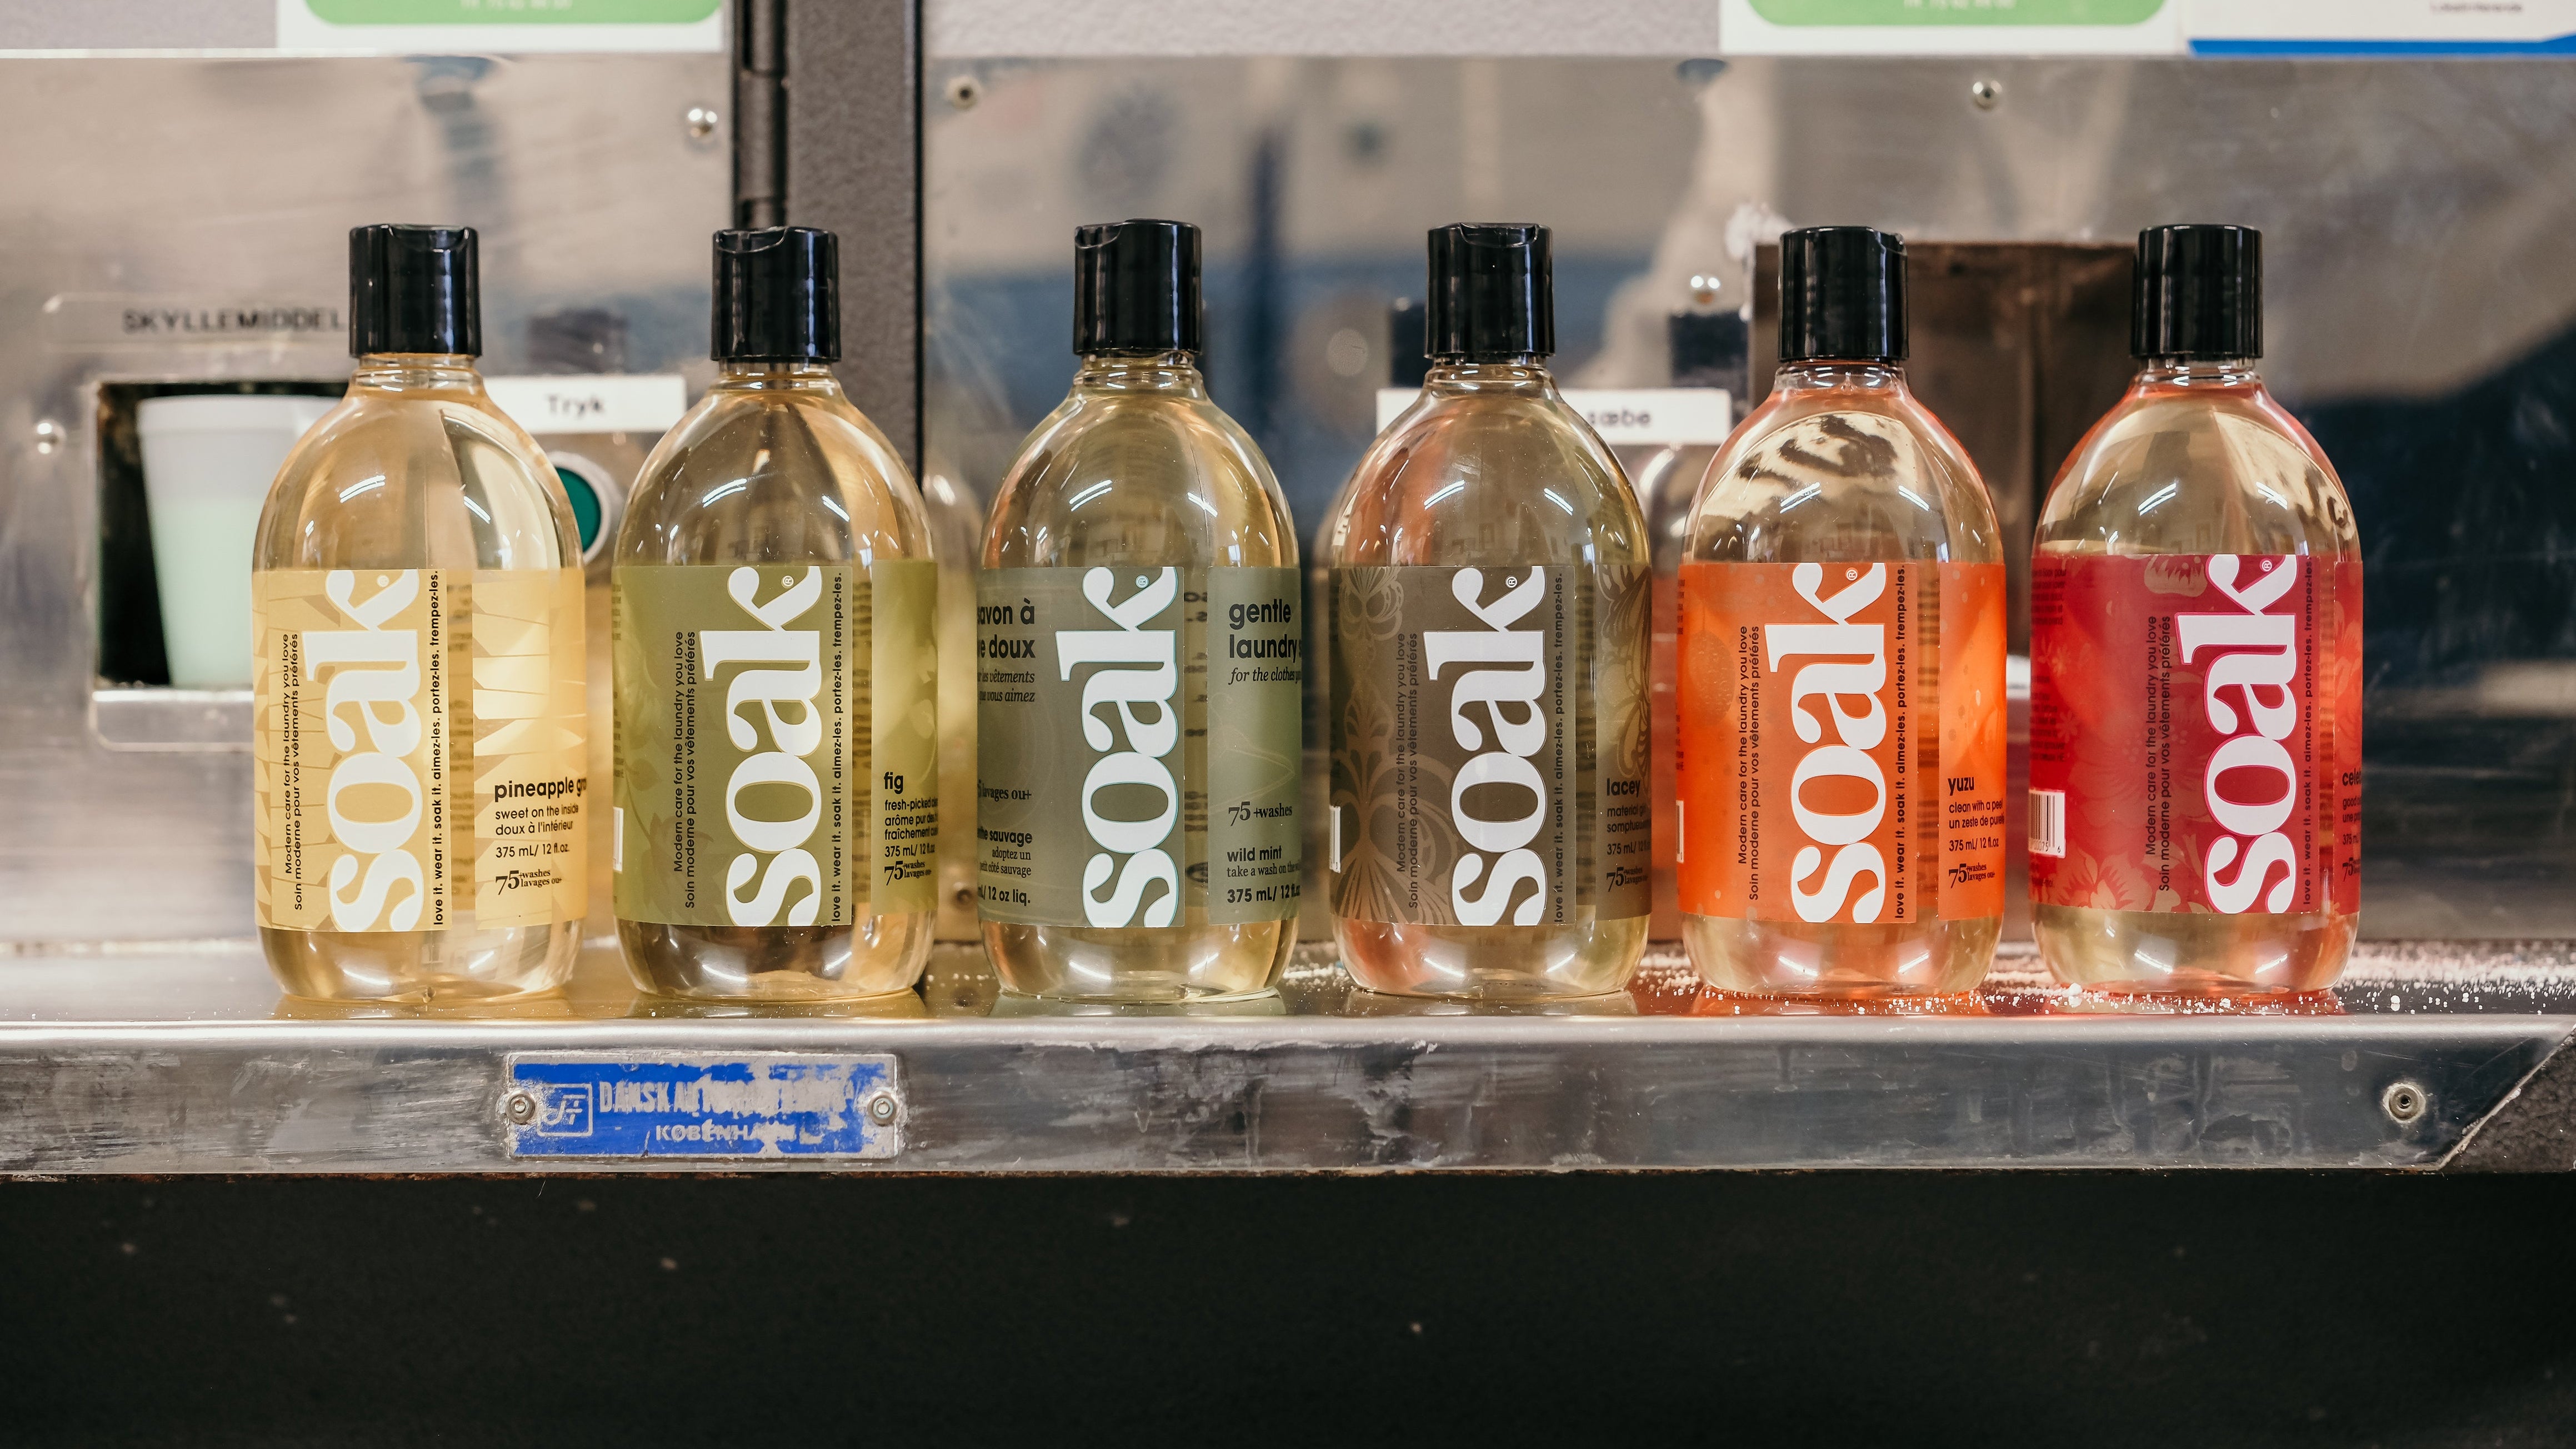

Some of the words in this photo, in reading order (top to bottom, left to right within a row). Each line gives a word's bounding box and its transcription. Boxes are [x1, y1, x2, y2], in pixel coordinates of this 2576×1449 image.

[1021, 598, 1035, 625] à
[1229, 599, 1291, 630] gentle
[1738, 626, 1748, 653] love
[2145, 615, 2157, 644] love
[281, 634, 289, 663] love
[685, 631, 697, 685] préférés
[989, 634, 1036, 658] doux
[1229, 634, 1297, 663] laundry
[2148, 646, 2160, 670] you
[289, 634, 300, 686] préférés
[1740, 656, 1750, 680] you
[283, 665, 292, 688] you
[990, 669, 1035, 683] vêtements
[1228, 667, 1249, 685] for
[1253, 666, 1268, 681] the
[1271, 666, 1295, 681] clothes
[987, 691, 1003, 701] vous
[1005, 688, 1036, 702] aimez
[2145, 674, 2159, 724] laundry
[282, 692, 293, 742] laundry
[1738, 684, 1750, 733] laundry
[290, 690, 299, 758] vêtements
[685, 688, 696, 756] vêtements
[2175, 554, 2298, 914] soak
[302, 569, 424, 931] soak
[699, 566, 822, 926] soak
[1056, 566, 1179, 927] soak
[1423, 566, 1547, 926] soak
[1738, 736, 1748, 757] the
[1764, 562, 1887, 923] soak
[2145, 727, 2157, 748] the
[283, 744, 291, 766] the
[2145, 751, 2157, 768] for
[686, 759, 695, 781] vos
[1738, 760, 1748, 778] for
[494, 776, 574, 802] pineapple
[884, 771, 903, 794] fig
[1606, 778, 1640, 797] lacey
[1948, 777, 1974, 796] yuzu
[2147, 771, 2157, 801] care
[293, 786, 302, 816] pour
[686, 784, 697, 815] pour
[884, 798, 931, 812] fresh-picked
[1739, 781, 1748, 811] care
[1895, 793, 1905, 823] soak
[1949, 801, 1970, 813] clean
[1972, 800, 1984, 811] with
[1986, 801, 1990, 810] a
[431, 799, 442, 829] soak
[495, 808, 528, 820] sweet
[531, 808, 544, 818] on
[547, 805, 559, 816] the
[561, 803, 579, 815] inside
[831, 798, 842, 828] soak
[884, 814, 914, 826] arôme
[916, 815, 926, 827] pur
[1228, 801, 1251, 826] 75
[1949, 820, 1960, 829] un
[1962, 816, 1978, 828] zeste
[1980, 815, 1988, 826] de
[496, 824, 525, 835] doux
[528, 821, 535, 833] à
[538, 820, 573, 833] l'intérieur
[884, 827, 930, 840] fraîchement
[989, 830, 1032, 847] sauvage
[1738, 814, 1748, 864] Modern
[2145, 805, 2157, 855] Modern
[293, 820, 302, 879] moderne
[496, 846, 515, 858] 375
[542, 843, 552, 854] 12
[685, 818, 695, 878] moderne
[884, 846, 901, 858] 375
[919, 844, 926, 855] 12
[992, 846, 1018, 861] adoptez
[1020, 851, 1031, 860] un
[1227, 847, 1255, 862] wild
[1259, 845, 1282, 860] mint
[1607, 844, 1621, 855] 375
[1949, 840, 1964, 851] 375
[1980, 837, 1986, 848] 12
[434, 848, 443, 880] wear
[833, 846, 841, 878] wear
[988, 861, 999, 873] côté
[1001, 865, 1032, 878] sauvage
[1227, 865, 1248, 877] take
[1251, 868, 1256, 876] a
[1258, 863, 1277, 875] wash
[1279, 865, 1286, 874] on
[1897, 842, 1905, 874] wear
[2342, 857, 2353, 882] 75
[495, 870, 519, 895] 75
[521, 878, 550, 888] lavages
[884, 861, 903, 886] 75
[904, 870, 924, 879] lavages
[1606, 867, 1624, 893] 75
[1948, 863, 1967, 889] 75
[1967, 872, 1987, 881] lavages
[293, 883, 303, 910] Soin
[685, 881, 695, 909] Soin
[988, 886, 997, 900] 12
[999, 890, 1009, 902] oz
[1013, 889, 1031, 906] liq.
[1227, 889, 1252, 903] 375
[1281, 885, 1289, 899] 12
[1894, 893, 1905, 919] love
[433, 899, 444, 925] love
[831, 896, 841, 922] love
[599, 1081, 669, 1112] DANSK
